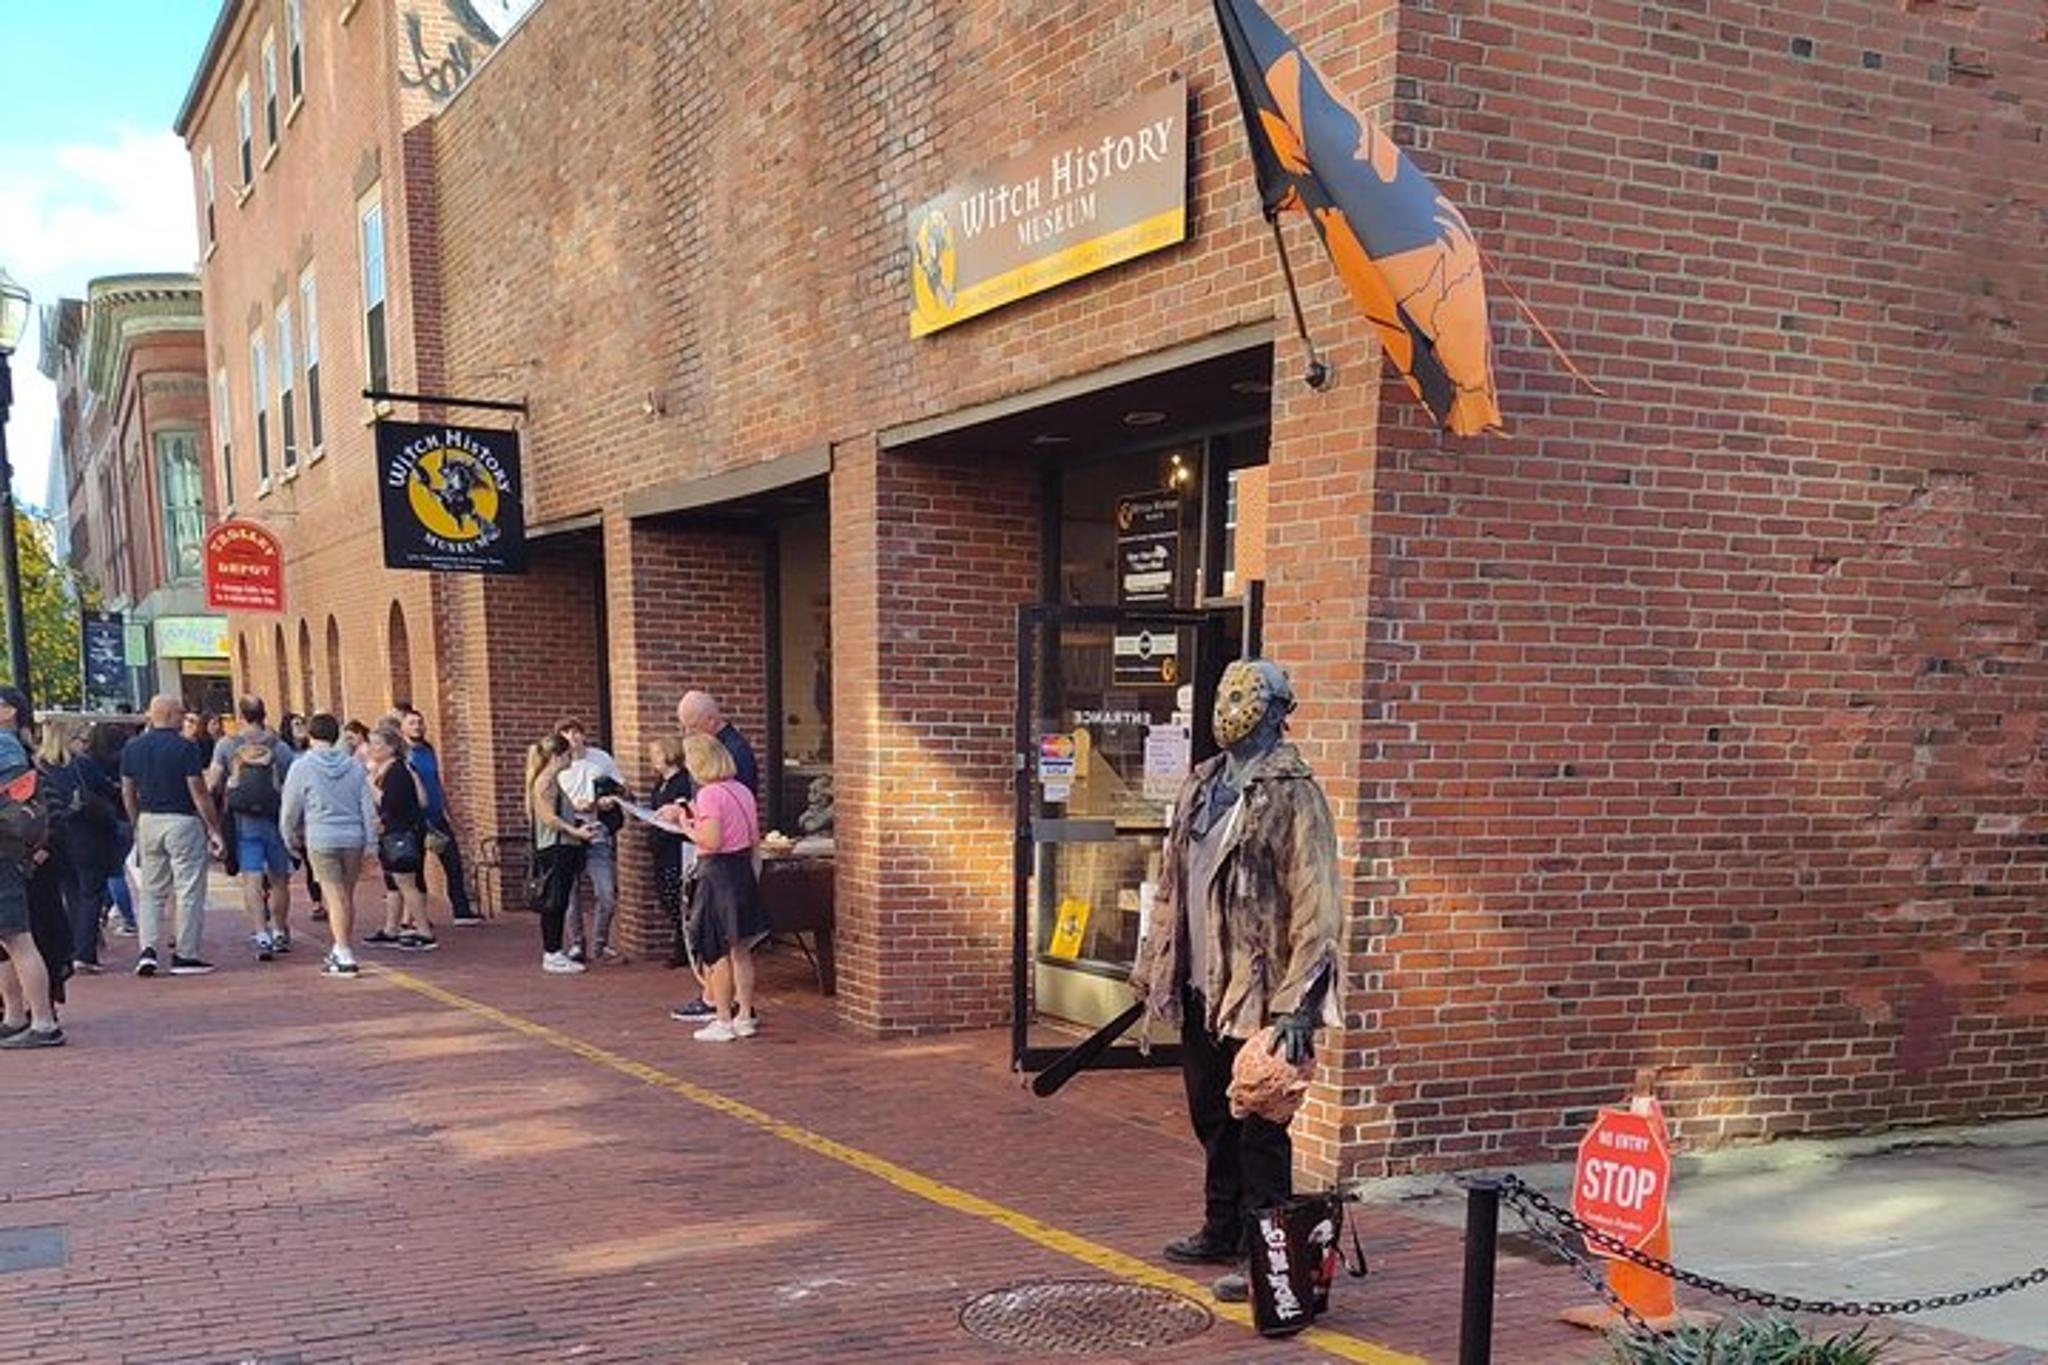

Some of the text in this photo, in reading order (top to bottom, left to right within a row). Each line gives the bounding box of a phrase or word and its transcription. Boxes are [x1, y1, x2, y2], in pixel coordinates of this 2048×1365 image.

[1016, 191, 1097, 248] MUSEUM
[218, 562, 271, 576] DEPOT
[1582, 1158, 1656, 1210] STOP
